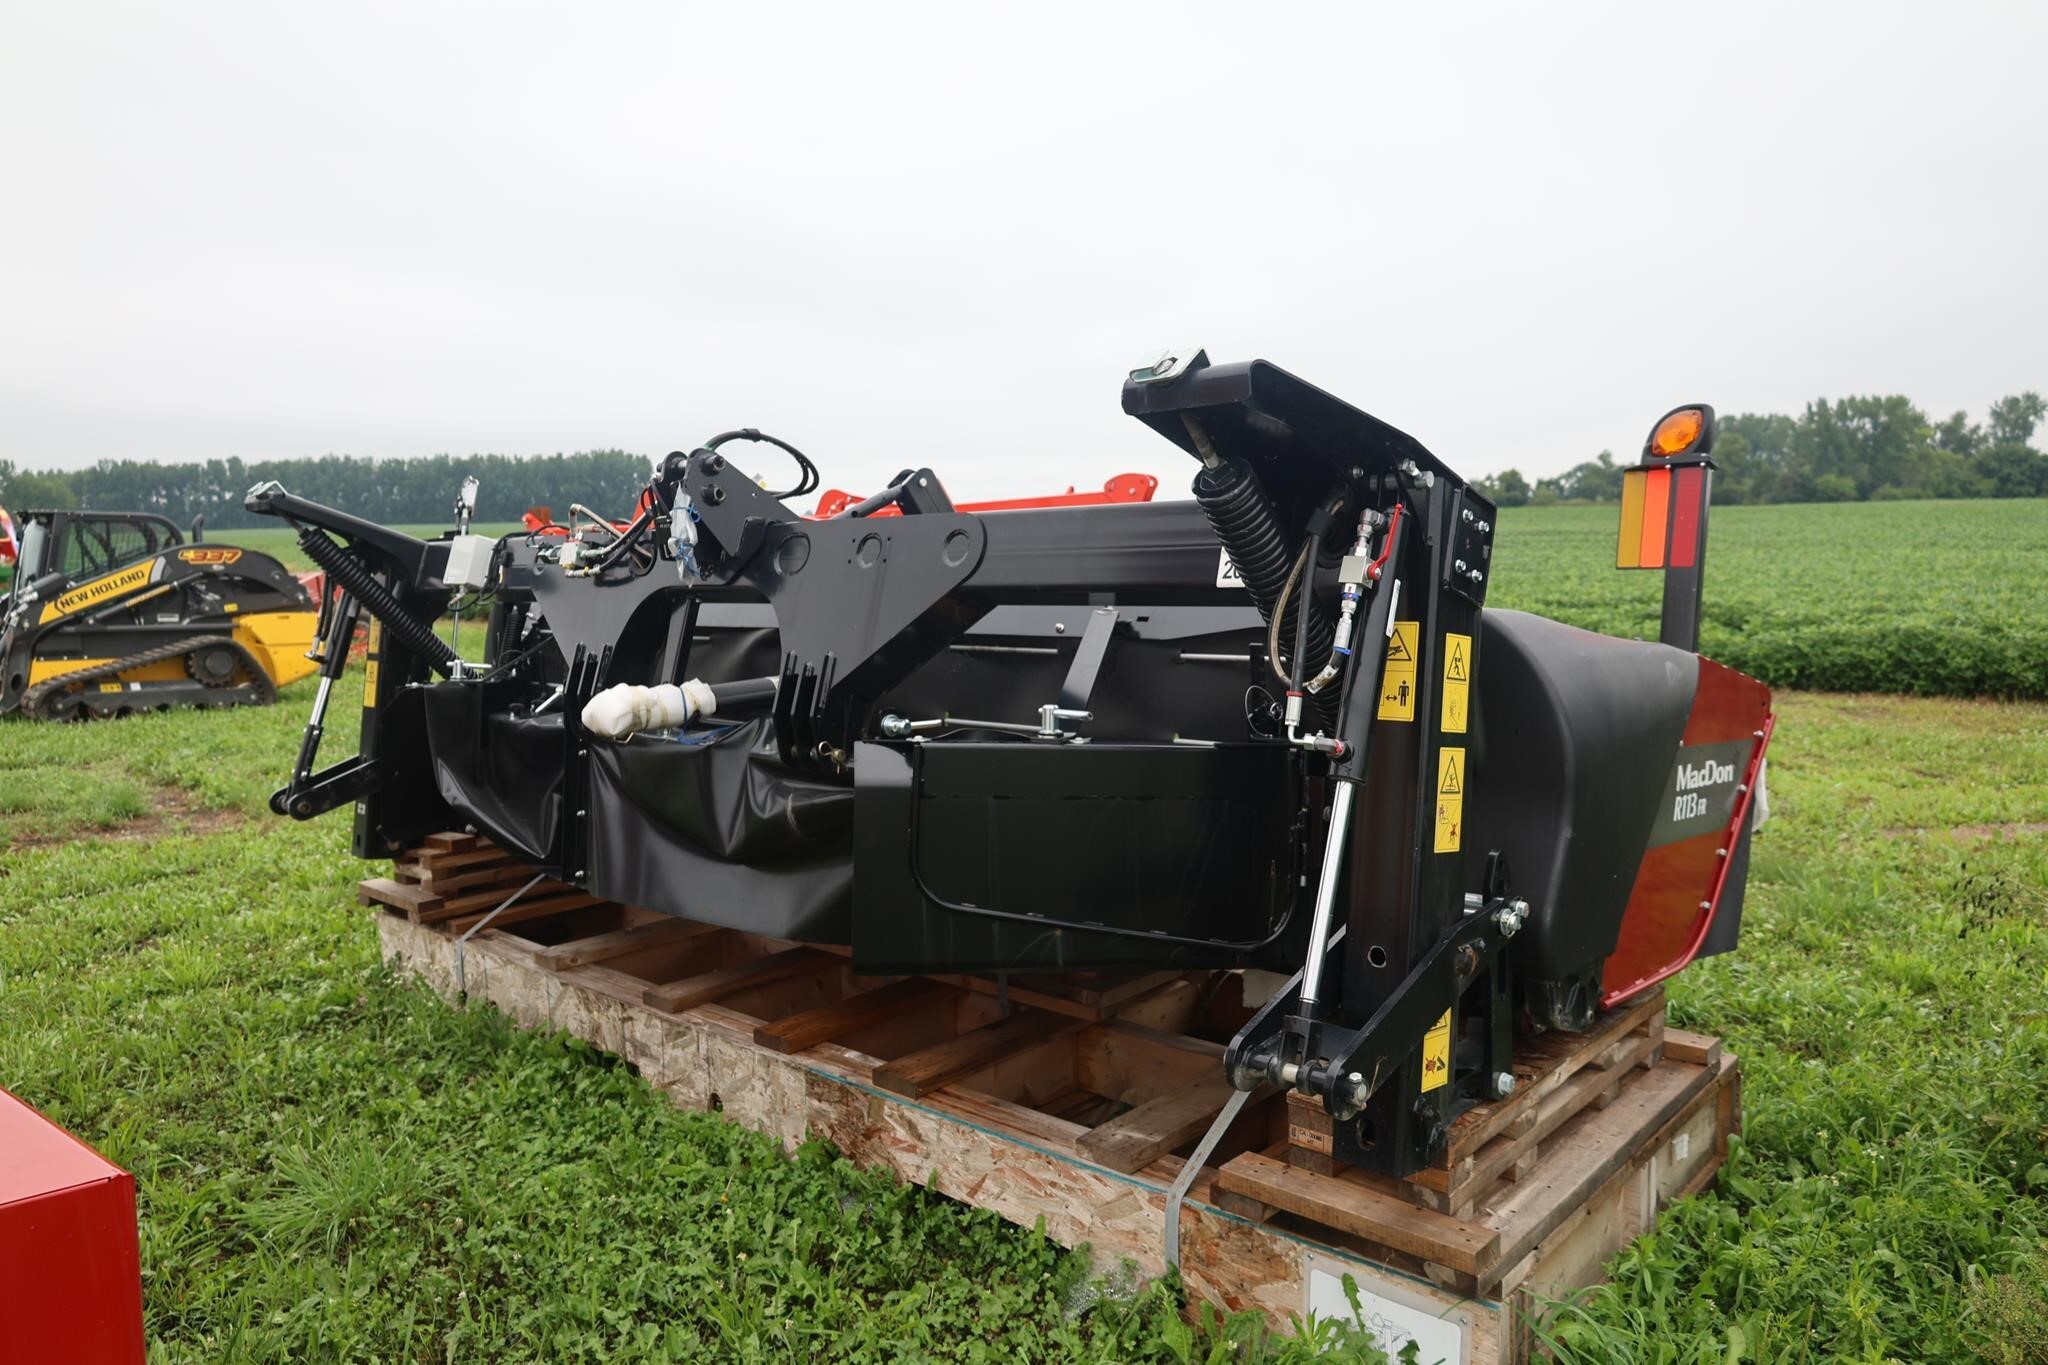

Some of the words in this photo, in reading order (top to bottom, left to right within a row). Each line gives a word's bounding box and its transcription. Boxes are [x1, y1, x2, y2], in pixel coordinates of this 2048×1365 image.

[60, 592, 88, 608] NEW
[90, 570, 145, 597] HOLLAND
[1675, 760, 1735, 792] MacDon
